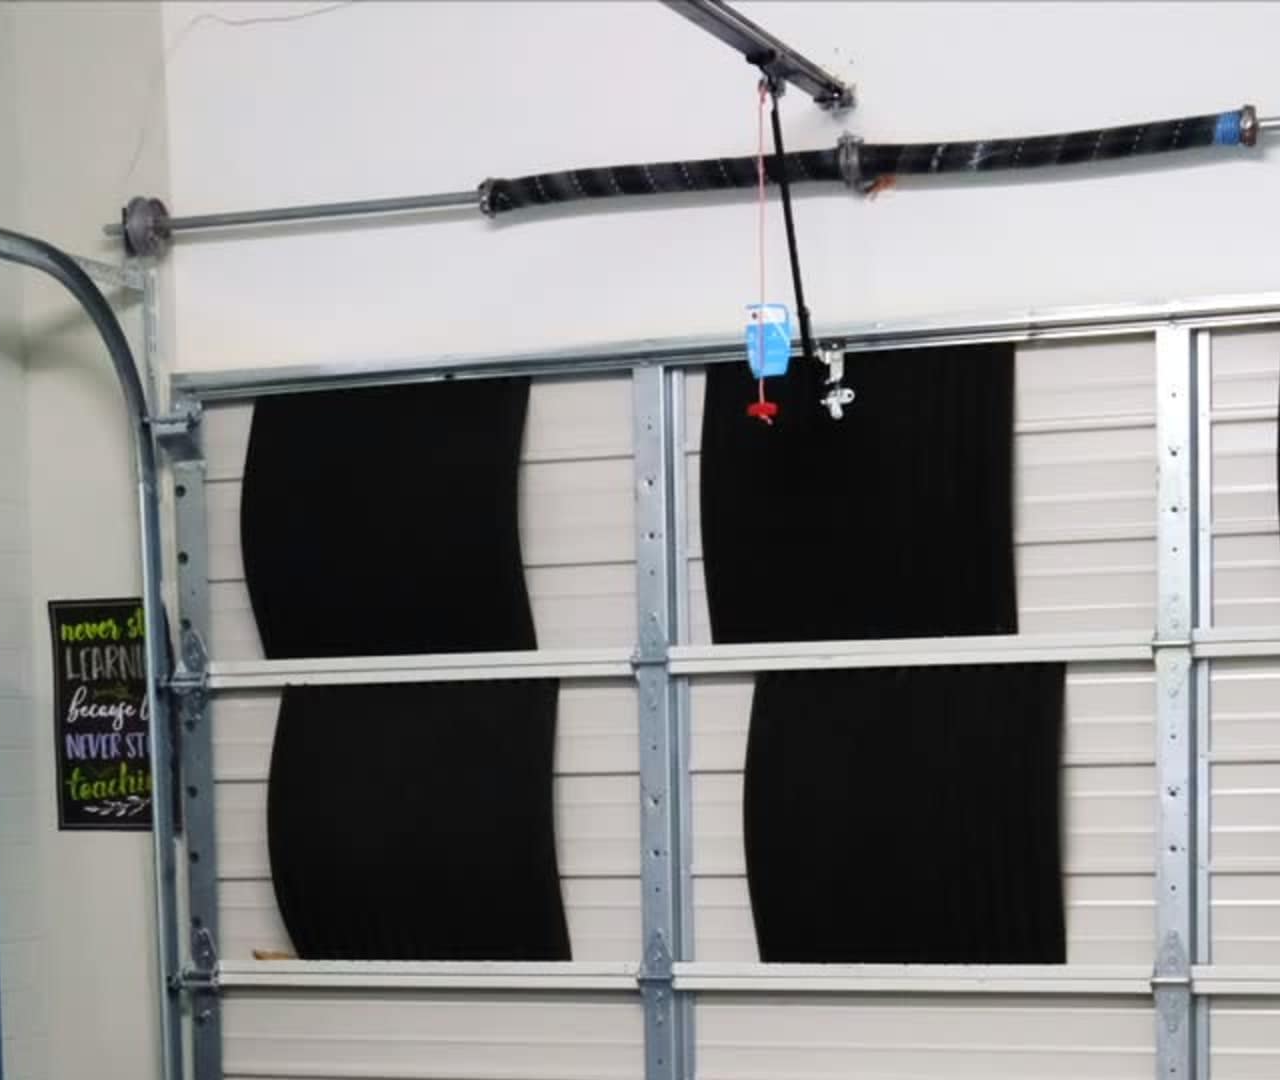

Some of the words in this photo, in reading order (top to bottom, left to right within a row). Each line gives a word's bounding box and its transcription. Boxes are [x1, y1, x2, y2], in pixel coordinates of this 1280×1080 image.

[60, 620, 121, 641] never
[65, 644, 144, 681] LEARNI
[66, 685, 136, 730] because
[65, 731, 122, 760] NEVER
[66, 762, 153, 800] teachi
